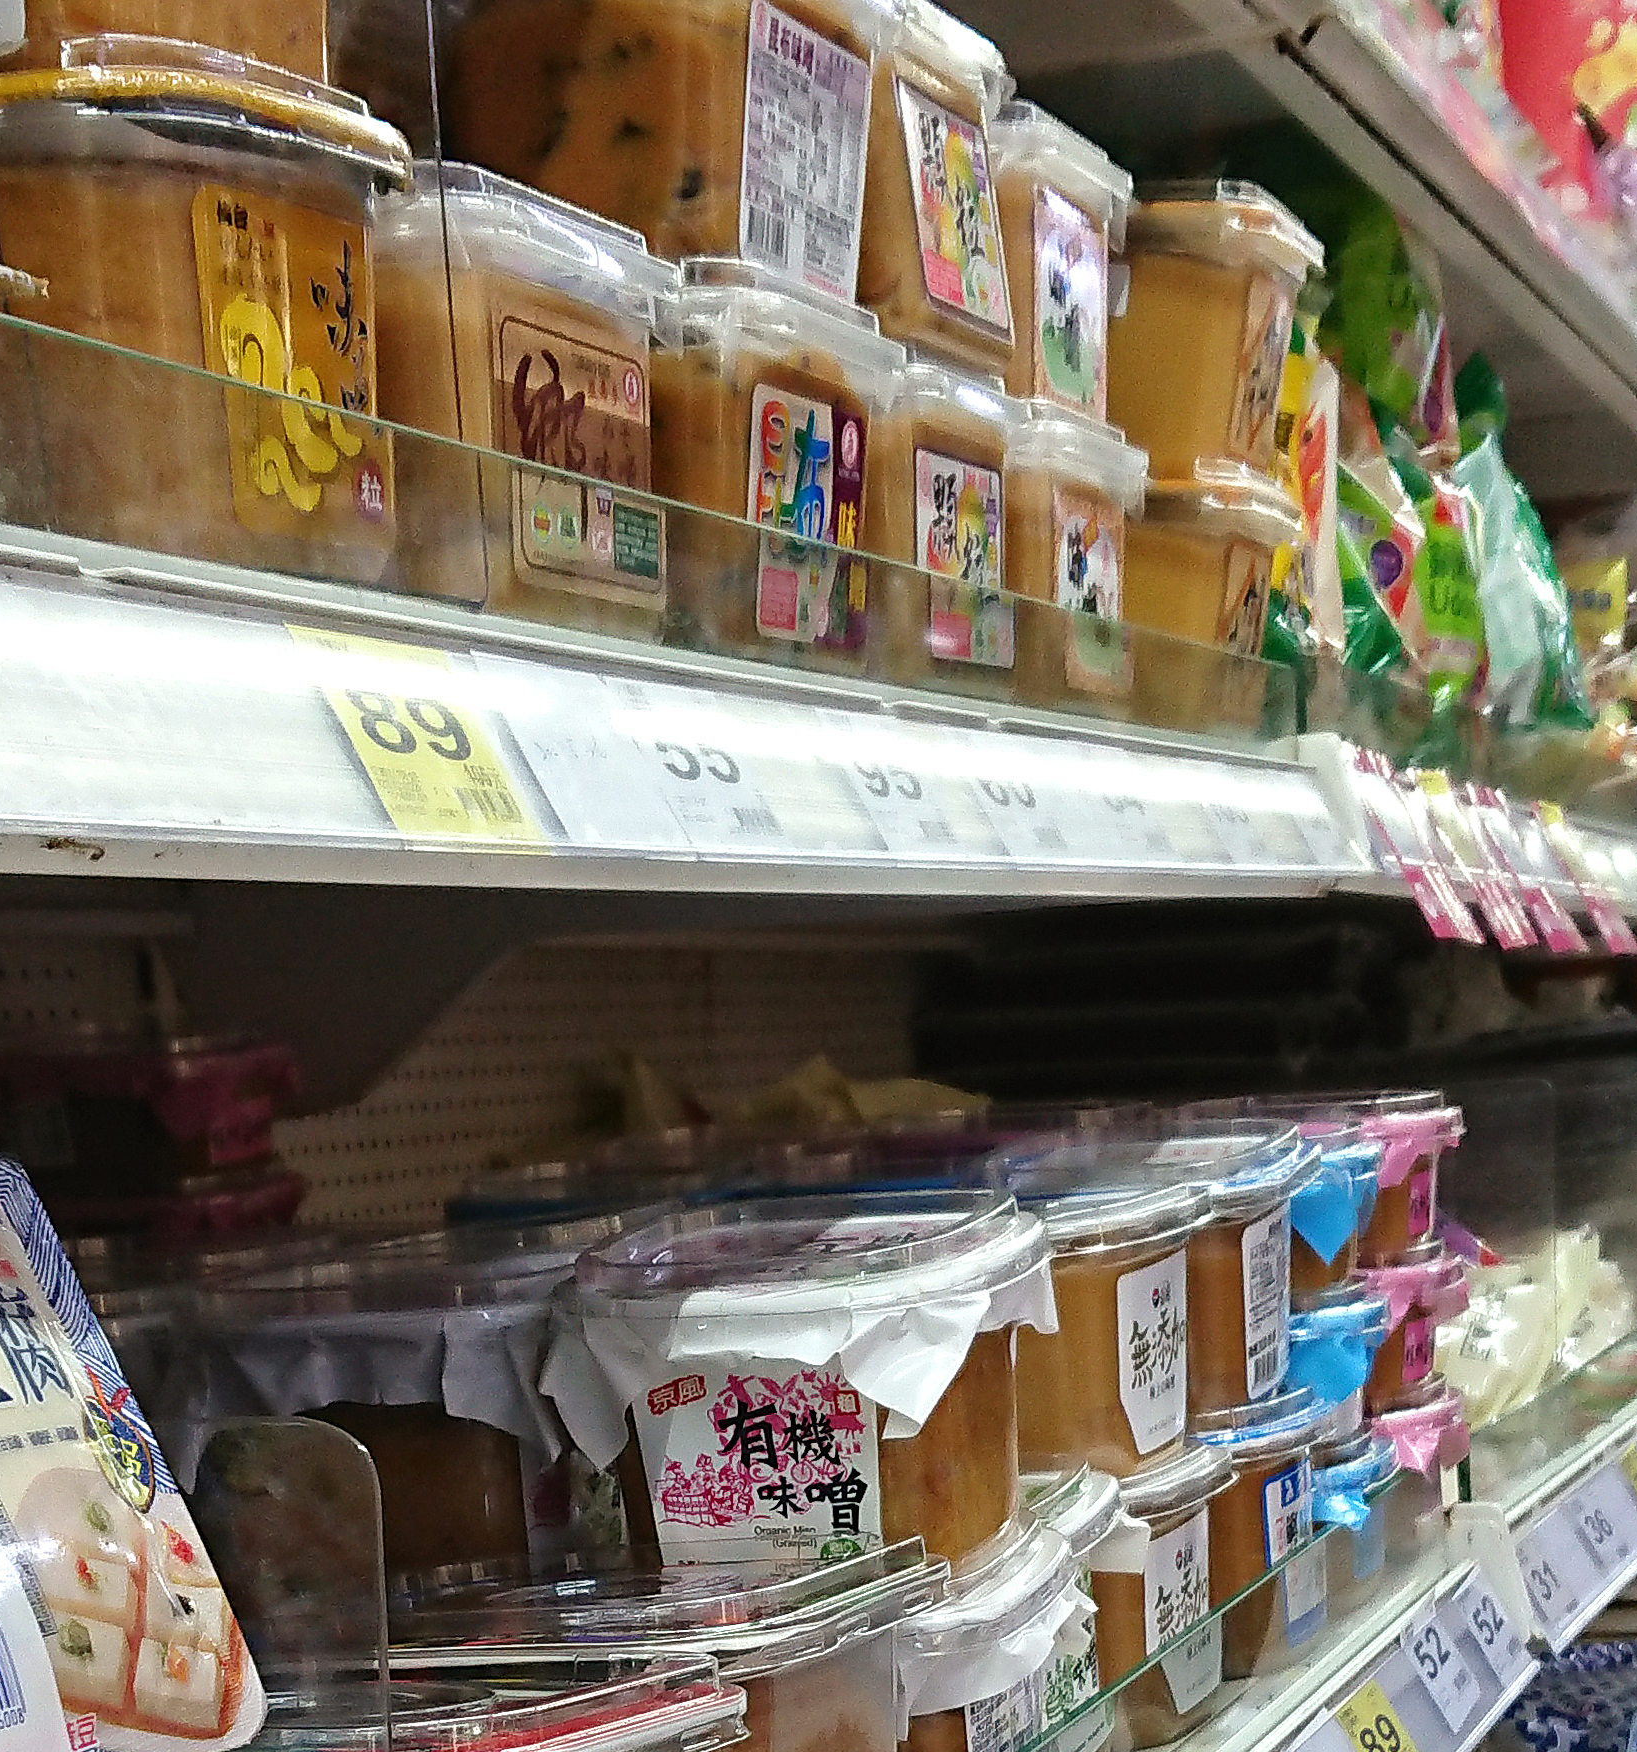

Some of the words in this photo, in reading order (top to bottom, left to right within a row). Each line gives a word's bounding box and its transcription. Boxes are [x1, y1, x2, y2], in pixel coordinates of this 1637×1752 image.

[361, 690, 473, 763] 89
[651, 1376, 704, 1411] 京風
[718, 1400, 843, 1471] 有機
[757, 1467, 868, 1537] 味噌
[1472, 1595, 1505, 1645] 52
[1414, 1626, 1451, 1680] 52
